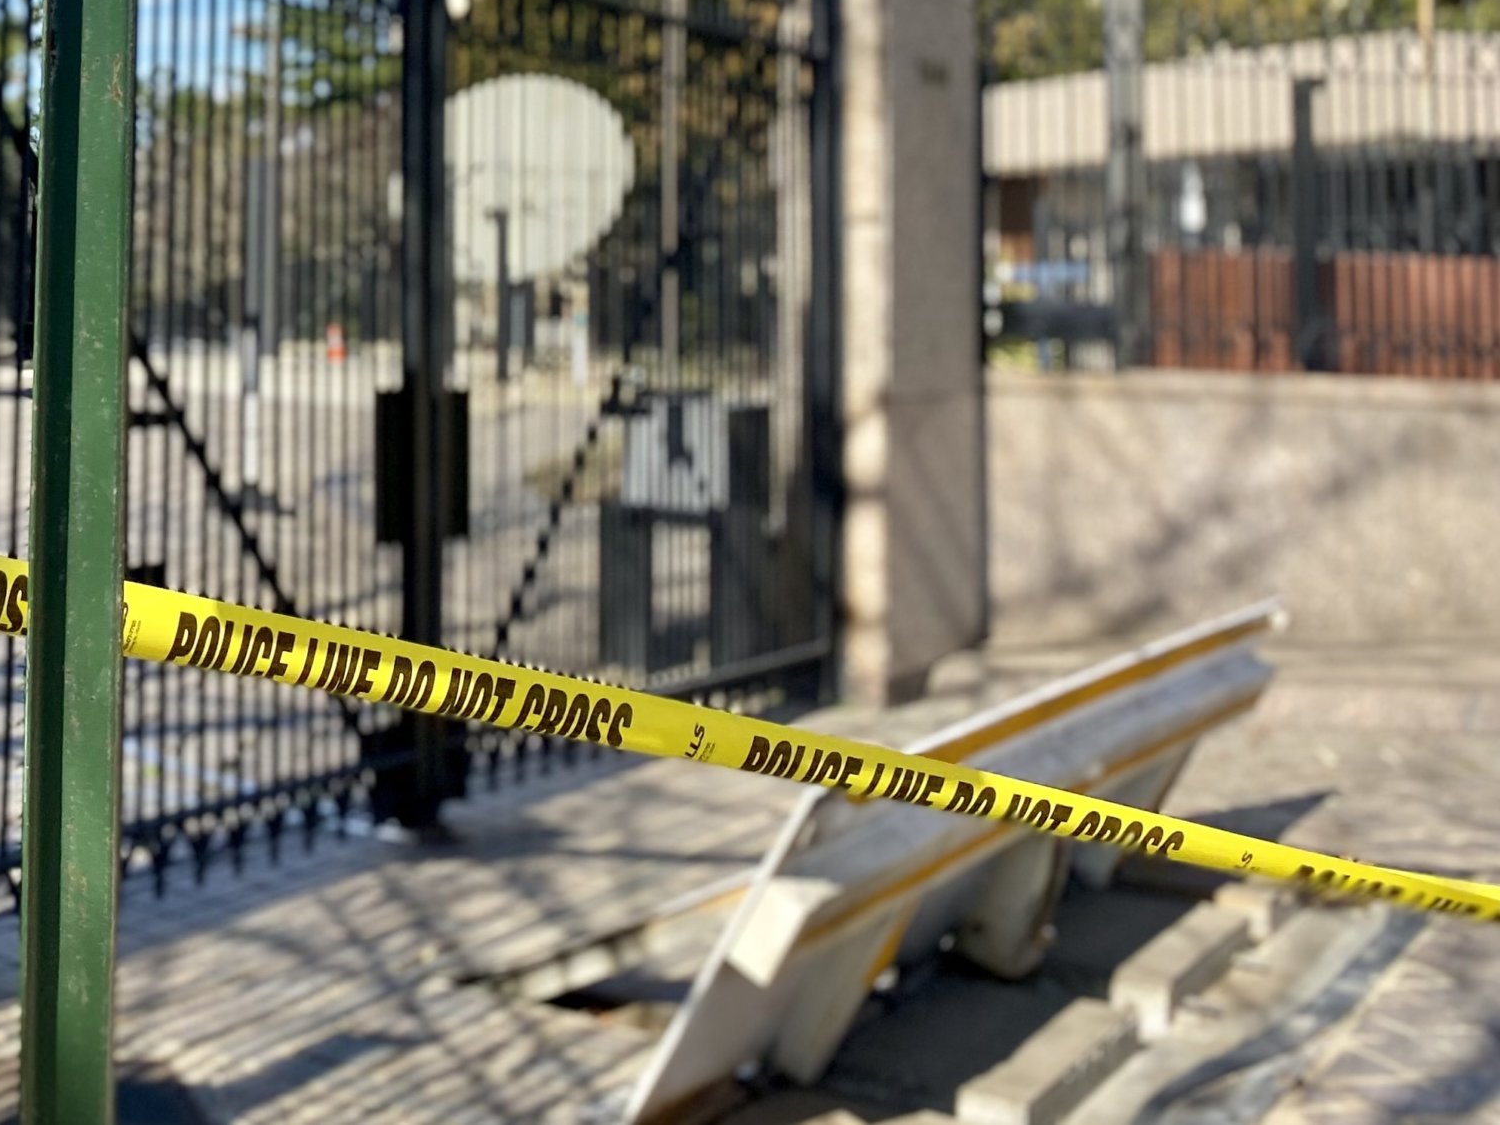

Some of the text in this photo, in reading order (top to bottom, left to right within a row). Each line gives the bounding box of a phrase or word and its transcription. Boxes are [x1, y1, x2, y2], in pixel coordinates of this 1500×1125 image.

[165, 611, 296, 679] POLICE
[294, 637, 382, 696] LINE
[382, 655, 436, 709] DO
[438, 667, 517, 723] NOT
[514, 683, 634, 747] CROSS
[740, 735, 865, 789] POLICE
